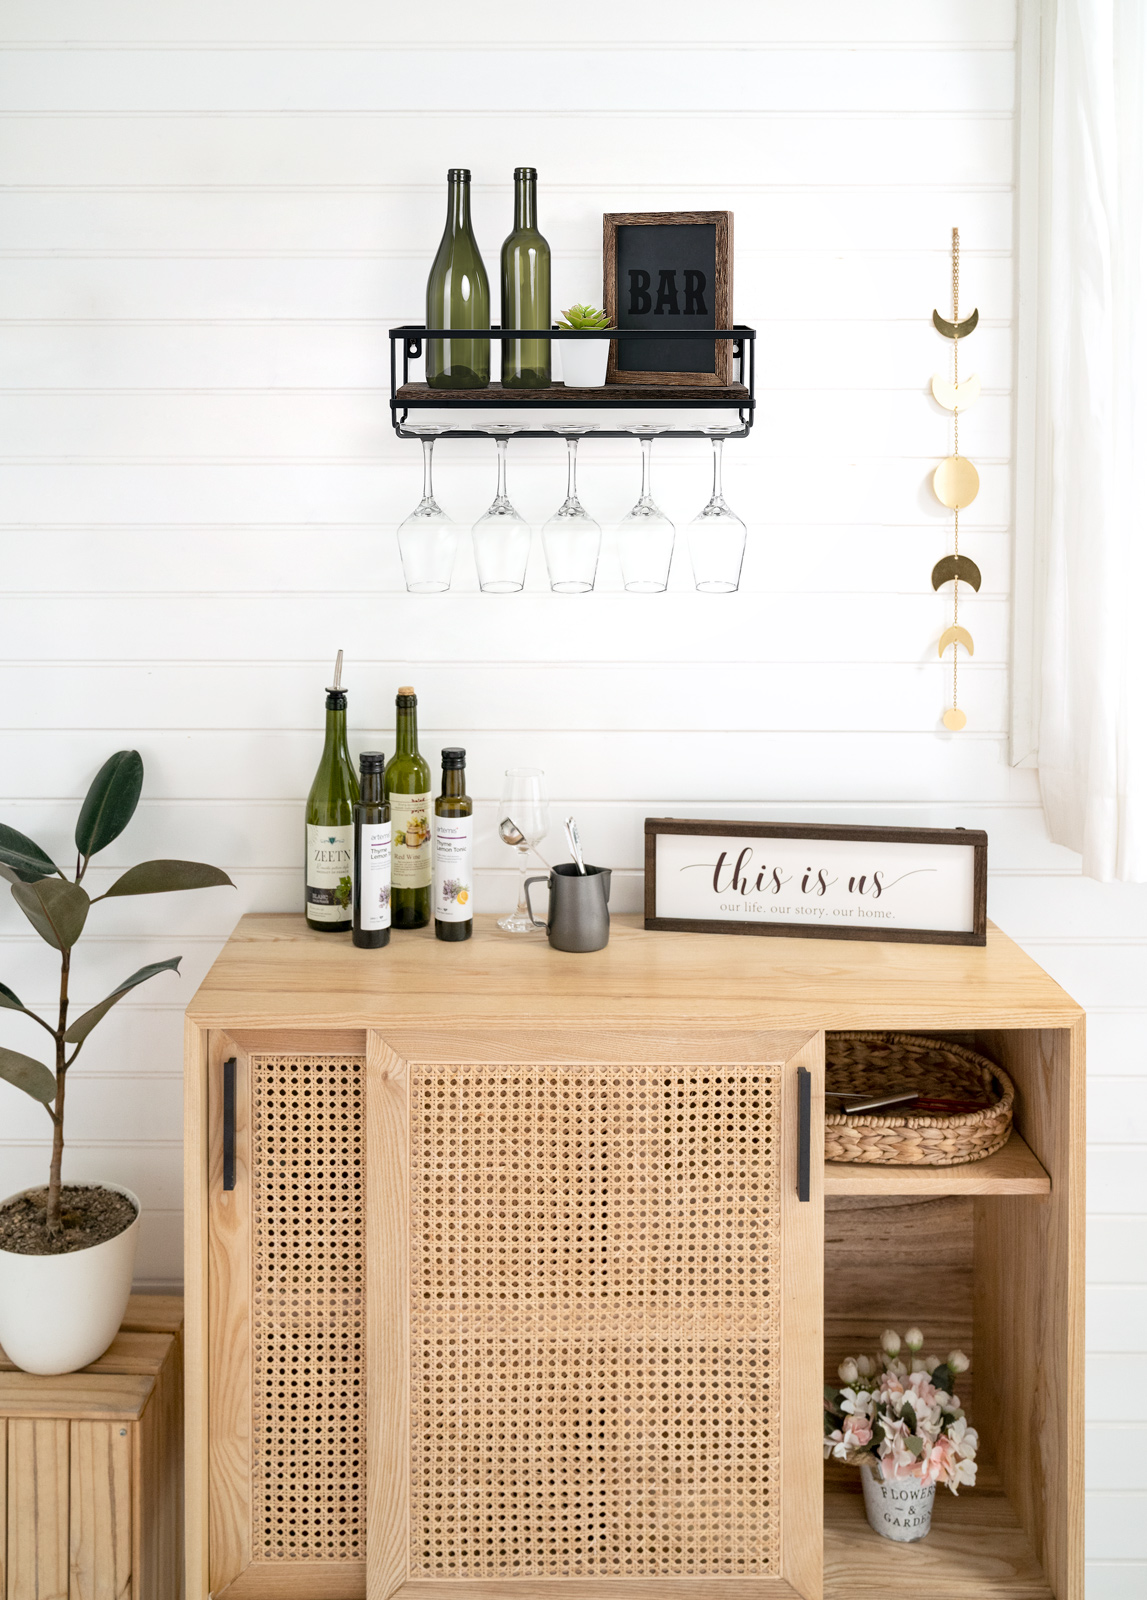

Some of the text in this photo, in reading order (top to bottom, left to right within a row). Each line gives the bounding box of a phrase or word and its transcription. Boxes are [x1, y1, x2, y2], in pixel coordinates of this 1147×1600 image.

[628, 269, 709, 315] BAR
[436, 839, 452, 847] Thyme
[679, 847, 793, 896] this
[801, 866, 839, 897] is
[720, 901, 896, 919] our life. our story. our home.
[908, 1506, 916, 1515] &
